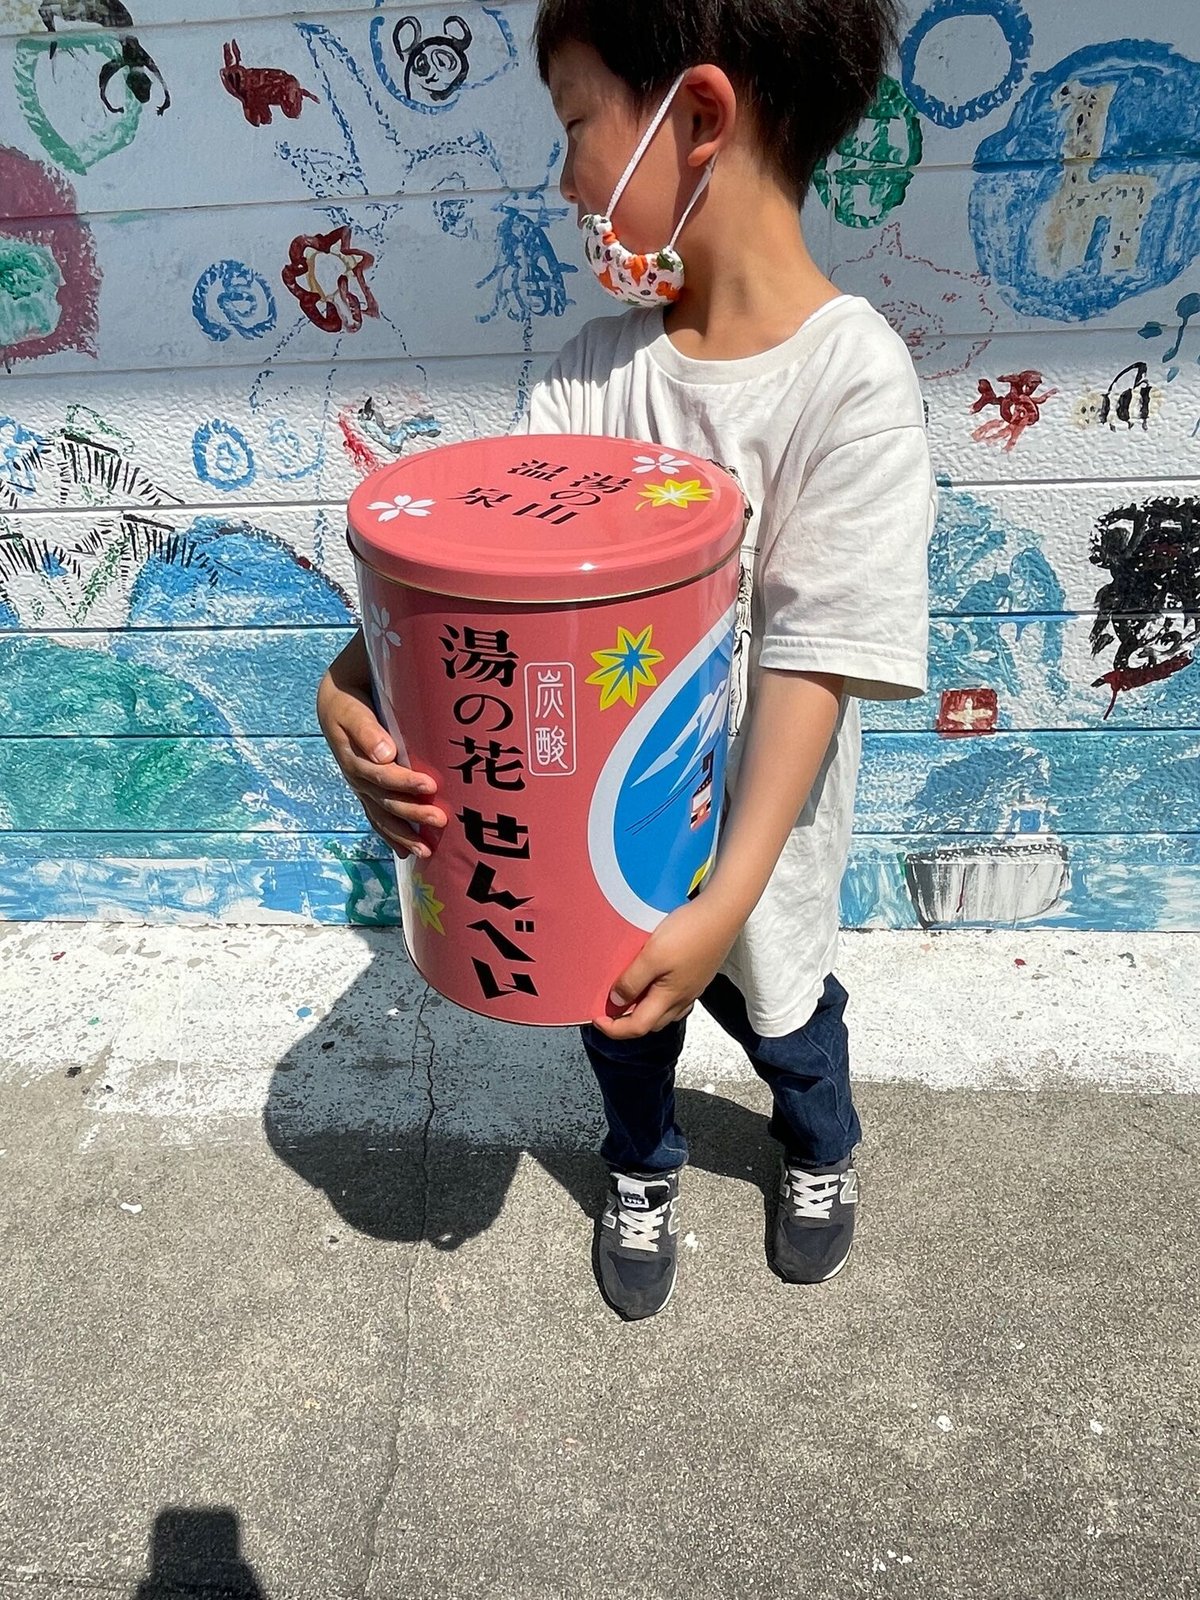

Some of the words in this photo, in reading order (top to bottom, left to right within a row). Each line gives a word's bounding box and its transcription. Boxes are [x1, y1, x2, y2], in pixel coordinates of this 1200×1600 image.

[446, 459, 569, 508] 温泉
[512, 472, 633, 525] 湯の山
[534, 669, 569, 770] 炭酸
[437, 623, 539, 1000] 湯の花せんべい
